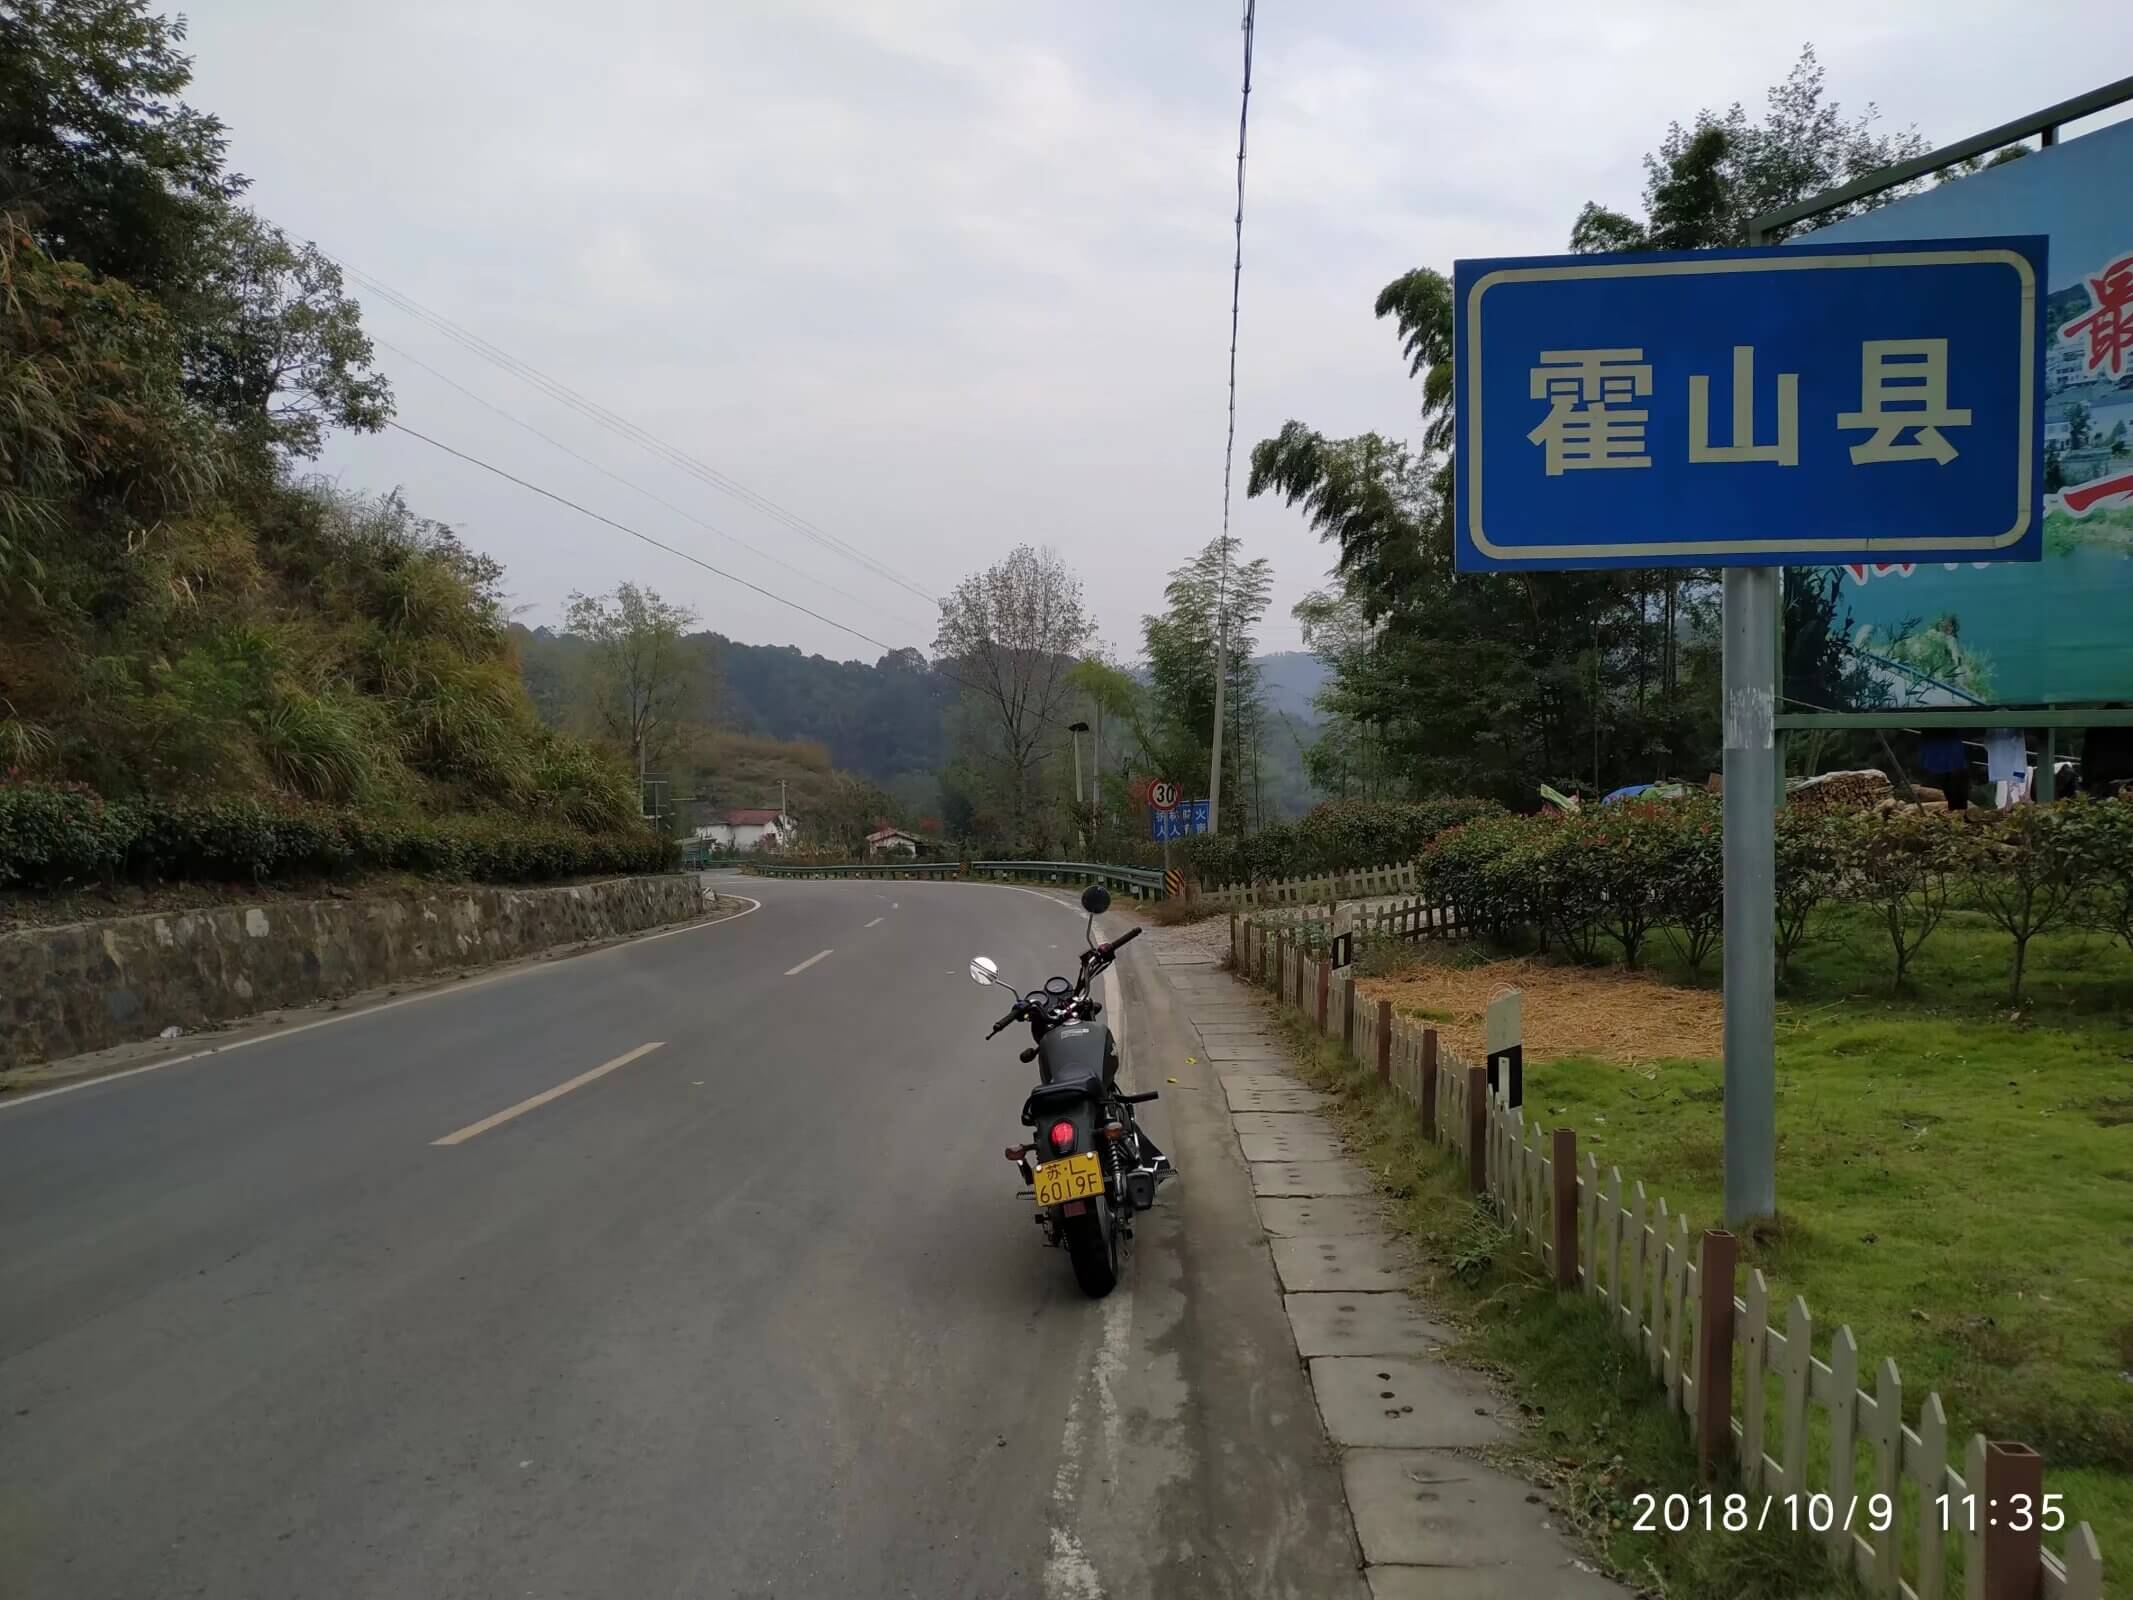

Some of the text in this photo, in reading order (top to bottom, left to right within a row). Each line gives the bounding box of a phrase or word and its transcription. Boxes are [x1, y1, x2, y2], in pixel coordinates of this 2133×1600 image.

[1526, 338, 1973, 476] 霍山县
[1156, 783, 1175, 803] 30
[1040, 1172, 1097, 1203] 6019F
